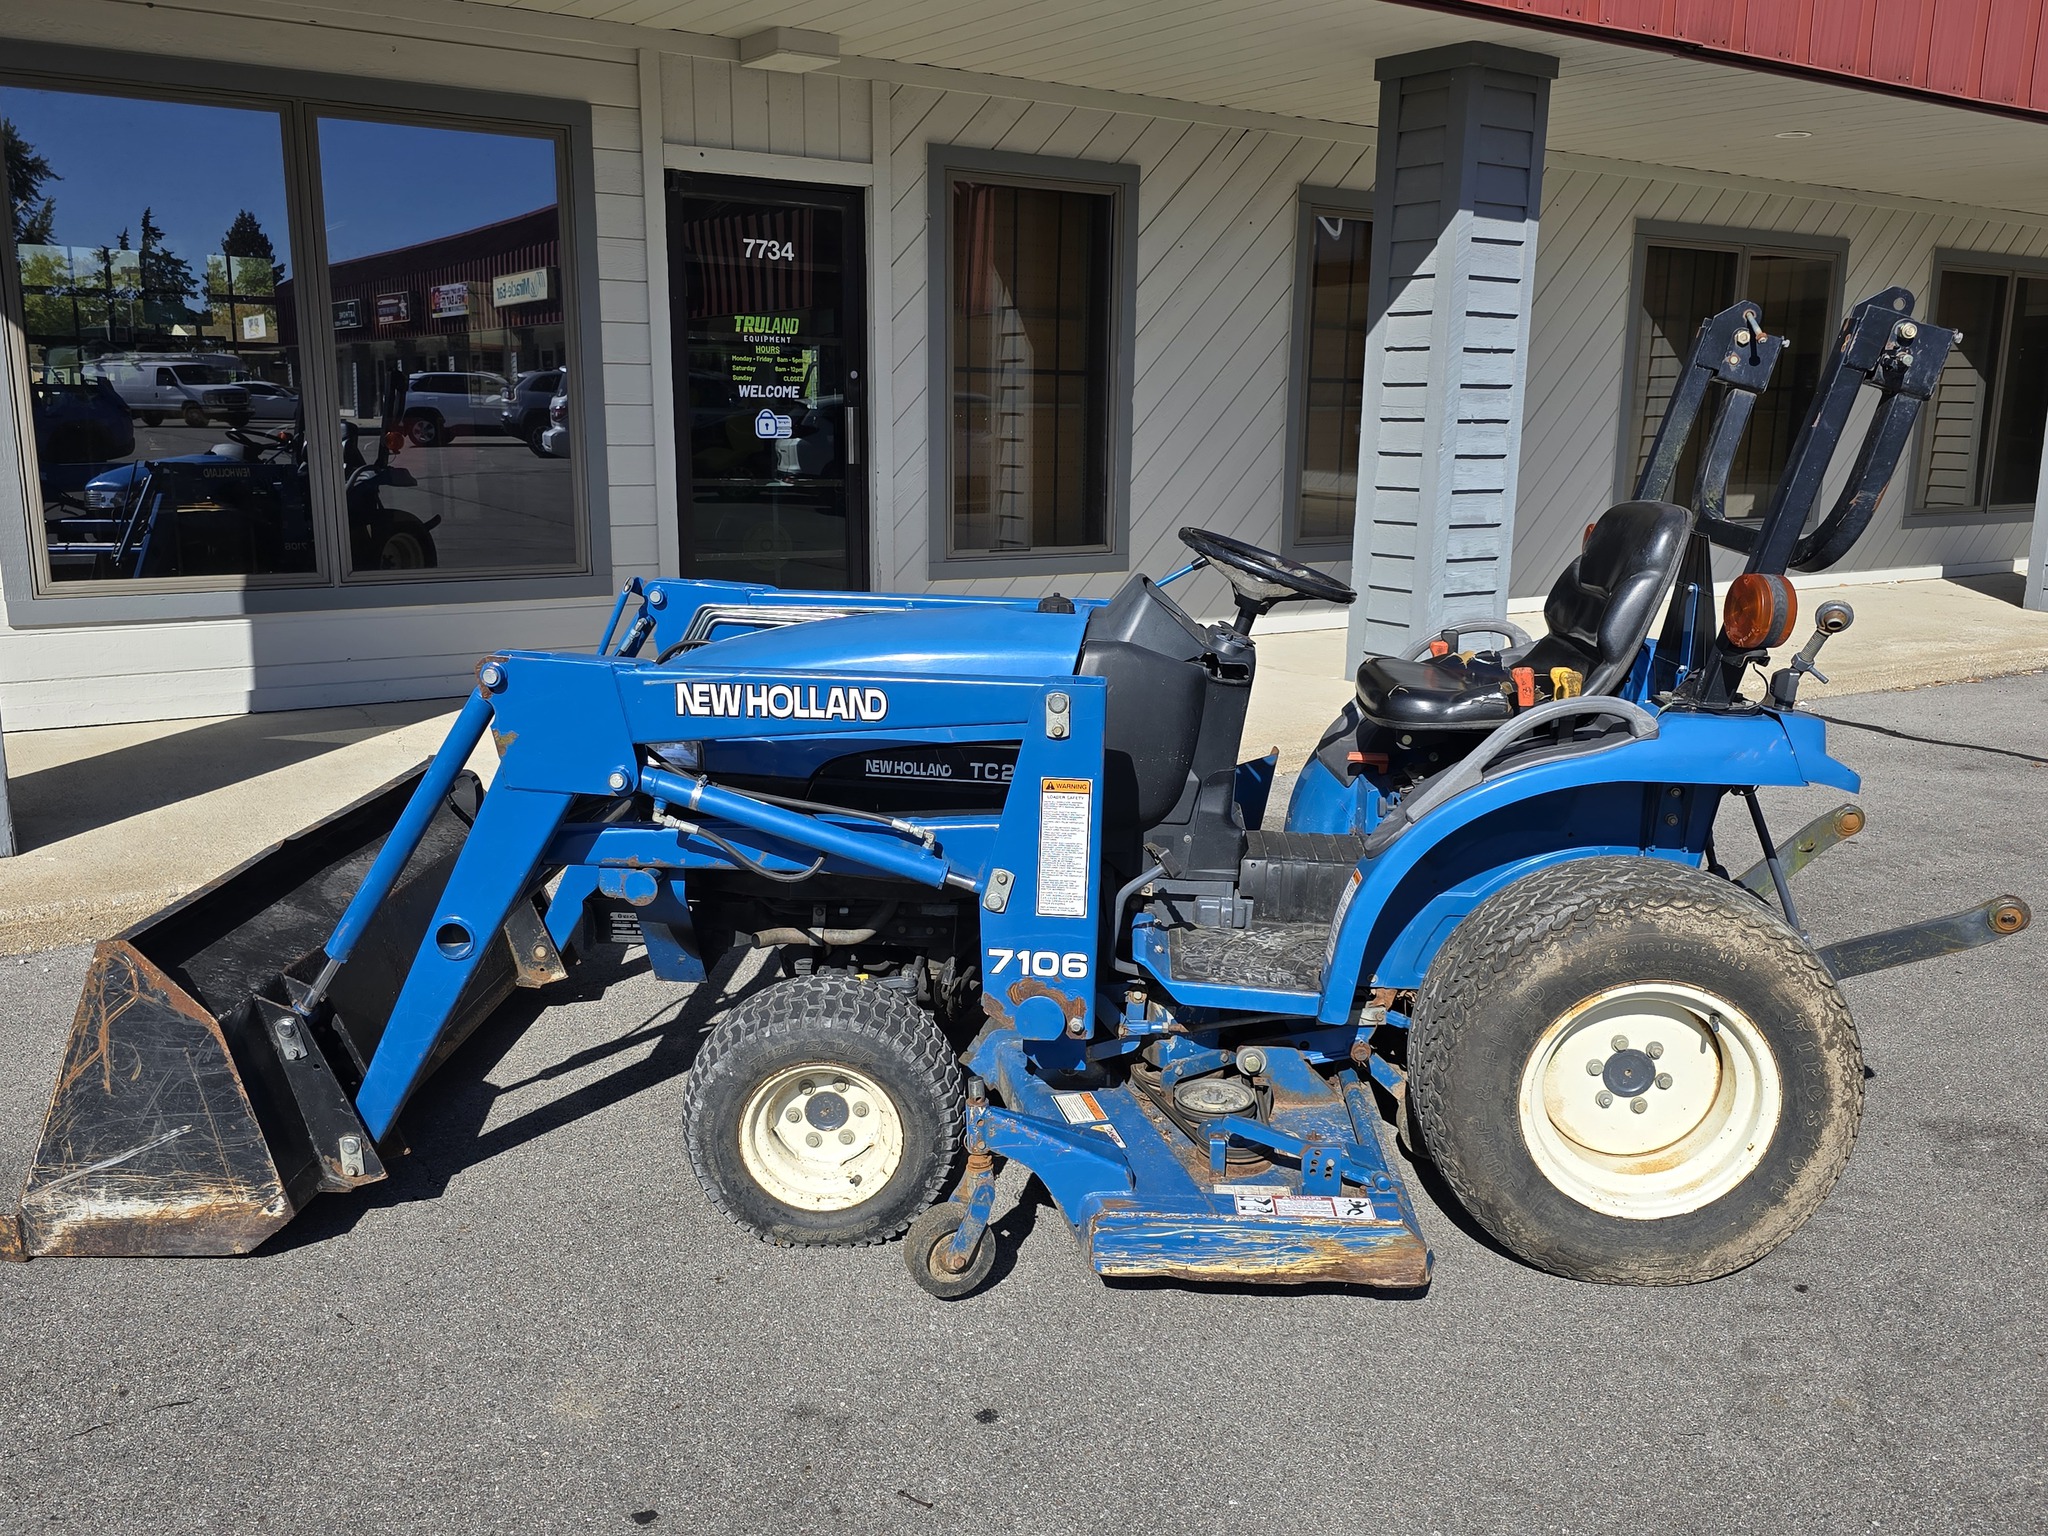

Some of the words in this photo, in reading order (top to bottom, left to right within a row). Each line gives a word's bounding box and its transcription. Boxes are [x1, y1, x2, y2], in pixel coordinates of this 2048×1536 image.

[743, 238, 794, 261] 7734
[734, 315, 800, 334] TRULAND
[743, 335, 791, 344] EQUIPMENT
[755, 345, 780, 354] HOURS
[731, 355, 752, 363] Monday
[756, 356, 773, 364] Friday
[732, 365, 756, 373] Saturday
[738, 385, 800, 398] WELCOME
[675, 682, 742, 716] NEW
[745, 683, 888, 721] HOLLAND
[865, 759, 893, 775] NEW
[894, 761, 952, 778] HOLLAND
[987, 947, 1089, 979] 7106
[1482, 984, 1546, 1066] FIELD
